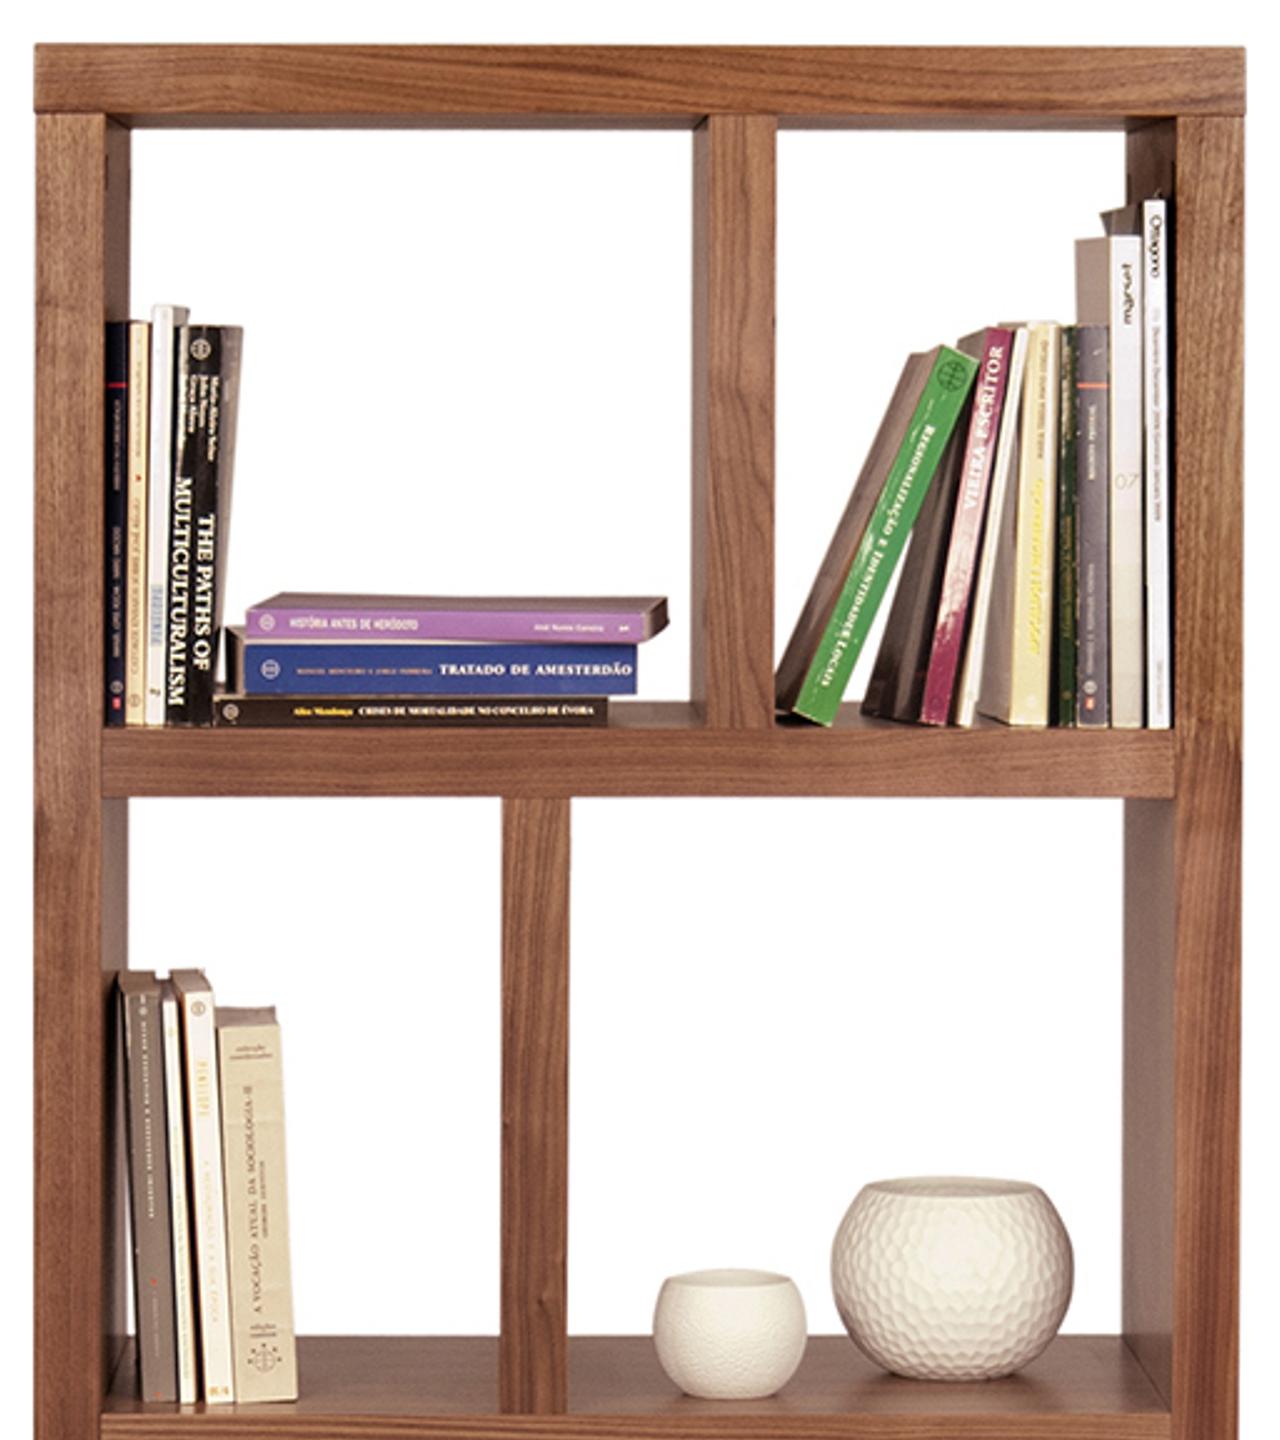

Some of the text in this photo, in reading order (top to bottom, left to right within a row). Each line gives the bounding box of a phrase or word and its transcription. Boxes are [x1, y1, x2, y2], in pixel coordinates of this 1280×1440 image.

[1148, 214, 1163, 278] Ottagono
[962, 345, 1005, 511] VIEIRA ESCRITOR
[167, 479, 195, 706] MULTICULTURALISM
[193, 513, 217, 670] THE PATHS OF
[289, 613, 419, 632] HISTÓRIA ANTES DE HERÓDOTO
[439, 659, 633, 676] TRATADO DE AMESTERDÃO
[247, 1178, 257, 1195] DA
[247, 1243, 264, 1302] VOCAÇÃO
